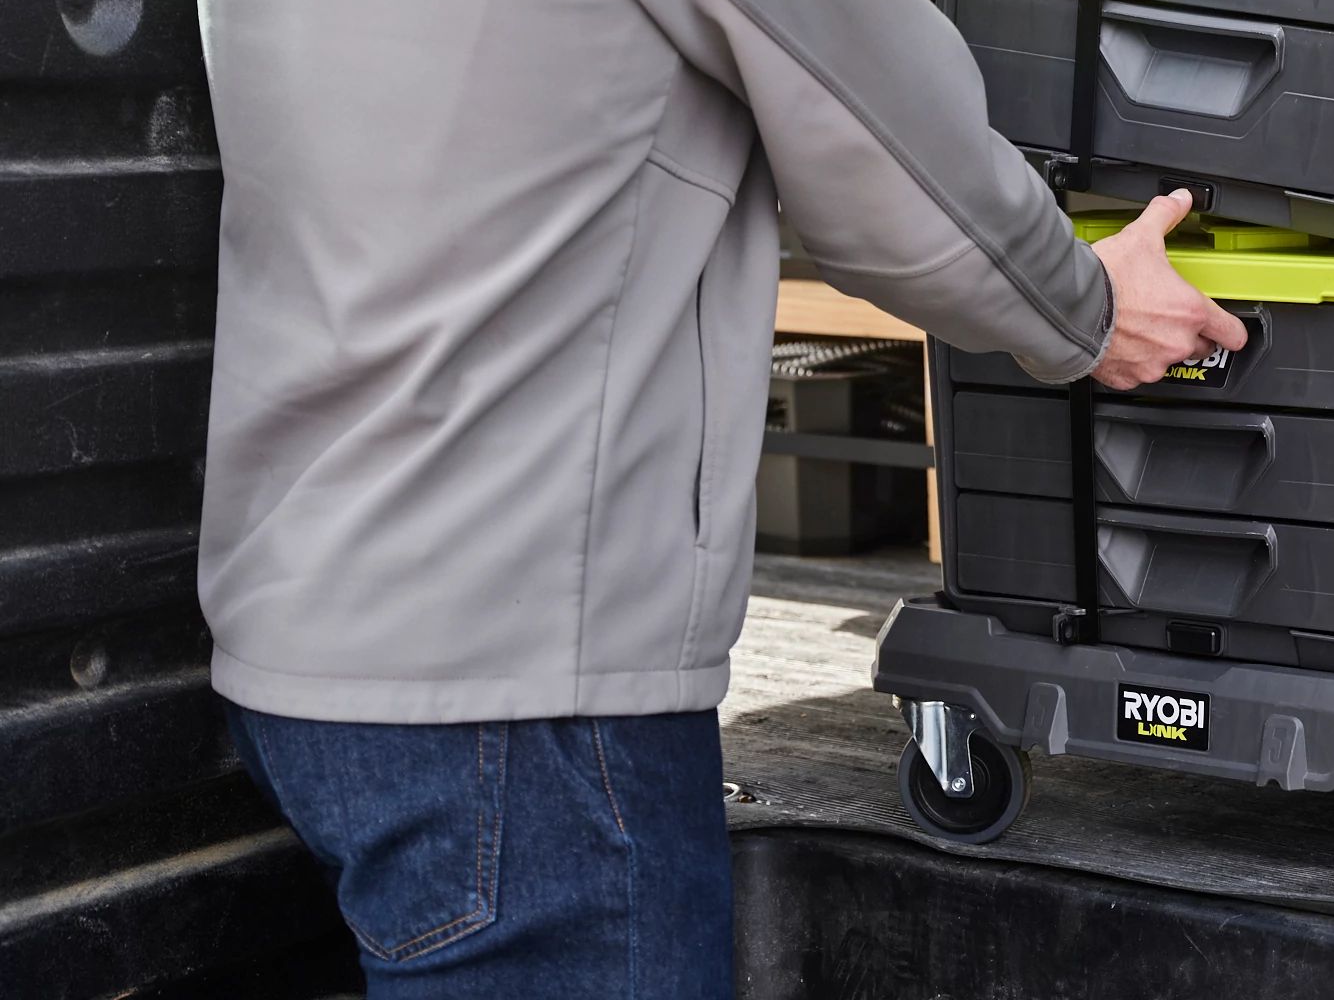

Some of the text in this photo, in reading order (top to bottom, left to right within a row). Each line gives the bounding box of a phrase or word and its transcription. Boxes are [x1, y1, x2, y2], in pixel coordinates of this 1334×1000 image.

[1164, 366, 1207, 380] INK
[1123, 690, 1204, 728] RYOBI
[1138, 722, 1187, 740] LINK
